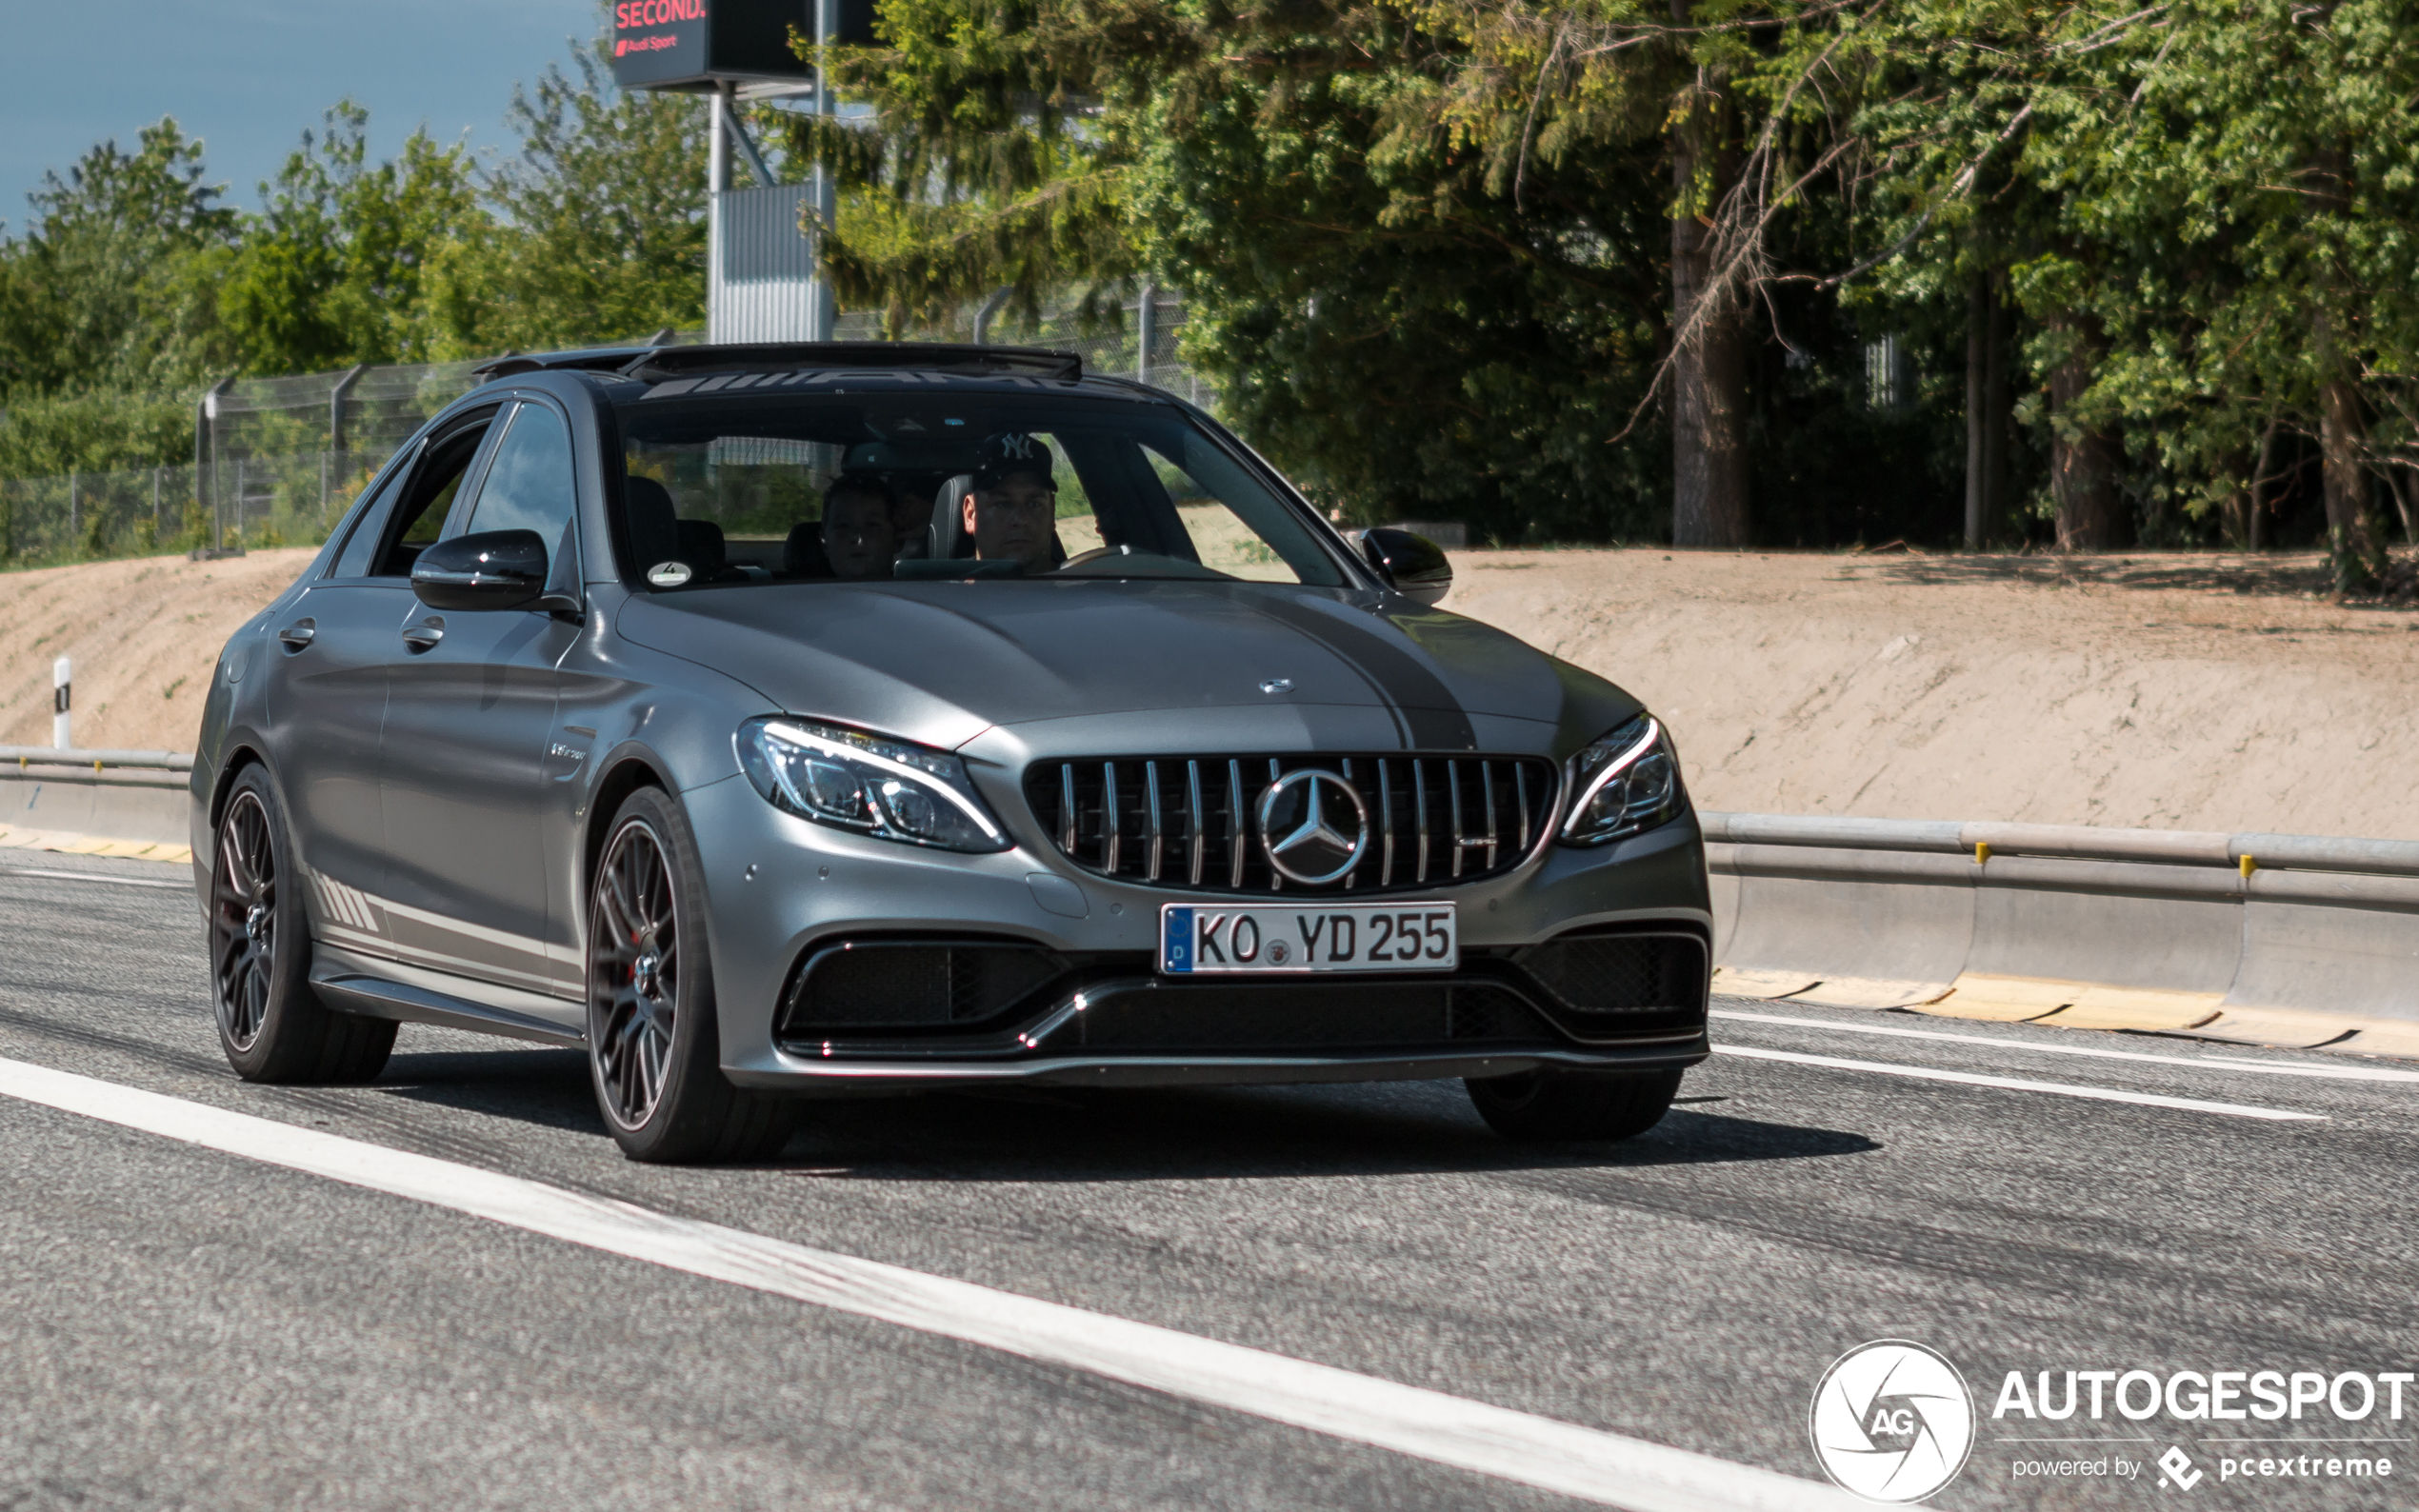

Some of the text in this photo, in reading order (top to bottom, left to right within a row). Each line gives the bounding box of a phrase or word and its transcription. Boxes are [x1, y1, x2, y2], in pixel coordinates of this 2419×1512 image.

[616, 0, 706, 29] SECOND.
[628, 35, 677, 51] Audi Sport
[1195, 911, 1450, 964] KO YD 255
